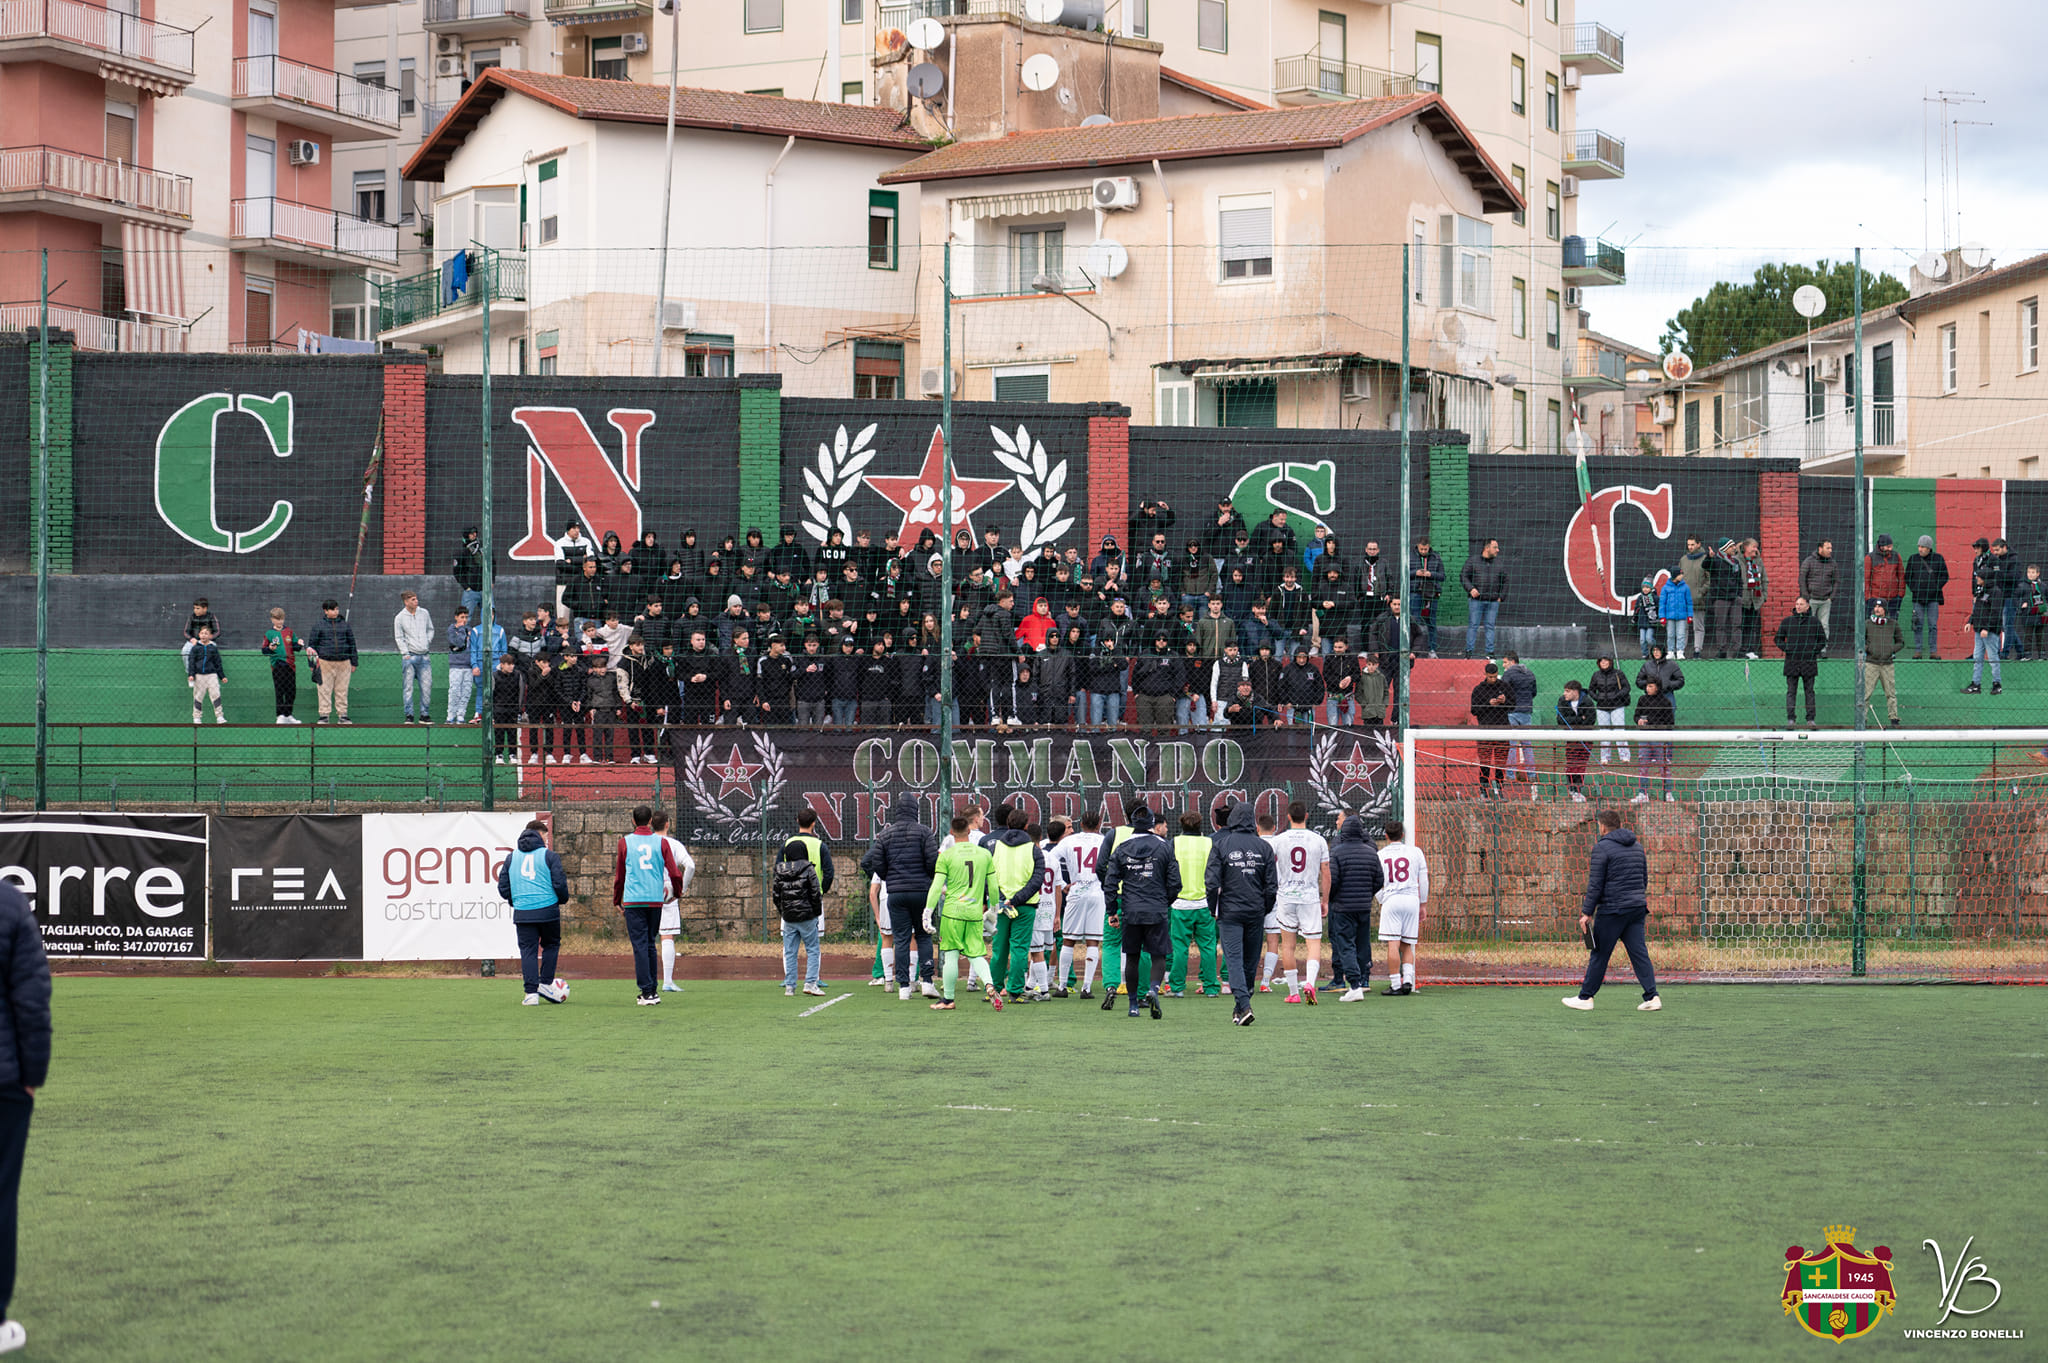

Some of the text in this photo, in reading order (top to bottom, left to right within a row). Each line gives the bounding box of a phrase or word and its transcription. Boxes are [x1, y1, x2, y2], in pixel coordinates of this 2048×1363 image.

[155, 392, 293, 553] C
[508, 406, 656, 561] N
[907, 484, 966, 524] 22
[1563, 483, 1673, 616] C
[723, 766, 748, 783] 22
[853, 737, 1245, 790] COMMANDO
[1345, 763, 1369, 780] 22
[690, 826, 789, 844] San Cataldo
[520, 853, 536, 880] 4
[637, 844, 653, 870] 2
[1073, 846, 1098, 874] 14
[1290, 846, 1307, 873] 9
[1384, 857, 1410, 883] 18
[965, 860, 974, 889] 1
[1039, 867, 1054, 895] 9
[384, 896, 512, 921] costruzion
[40, 925, 194, 938] TAGLIAFUOCO, DA GARAGE
[94, 941, 120, 951] info:
[123, 941, 194, 952] 347.0707167
